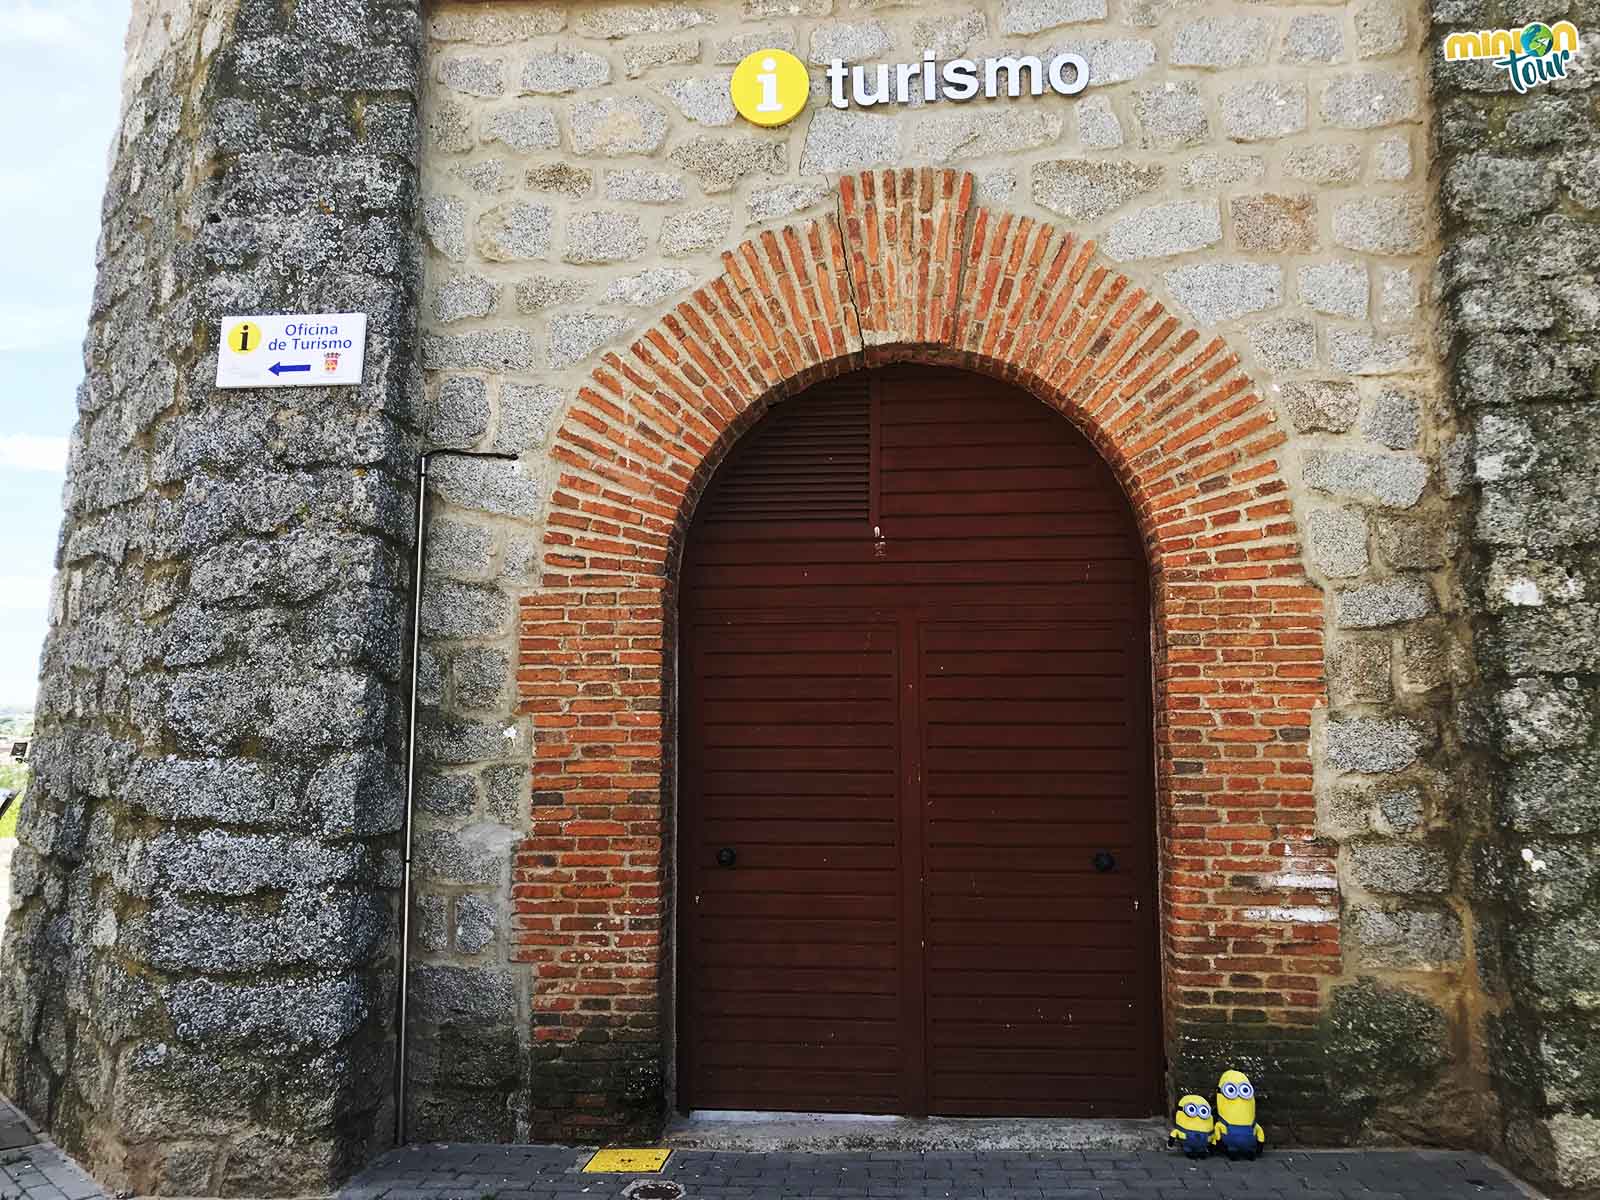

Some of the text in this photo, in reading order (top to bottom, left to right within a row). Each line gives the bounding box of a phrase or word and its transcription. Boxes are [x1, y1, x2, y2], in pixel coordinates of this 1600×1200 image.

[754, 49, 1091, 112] i turismo
[238, 324, 249, 351] i
[285, 323, 338, 337] Oficina
[268, 337, 352, 351] de Turismo
